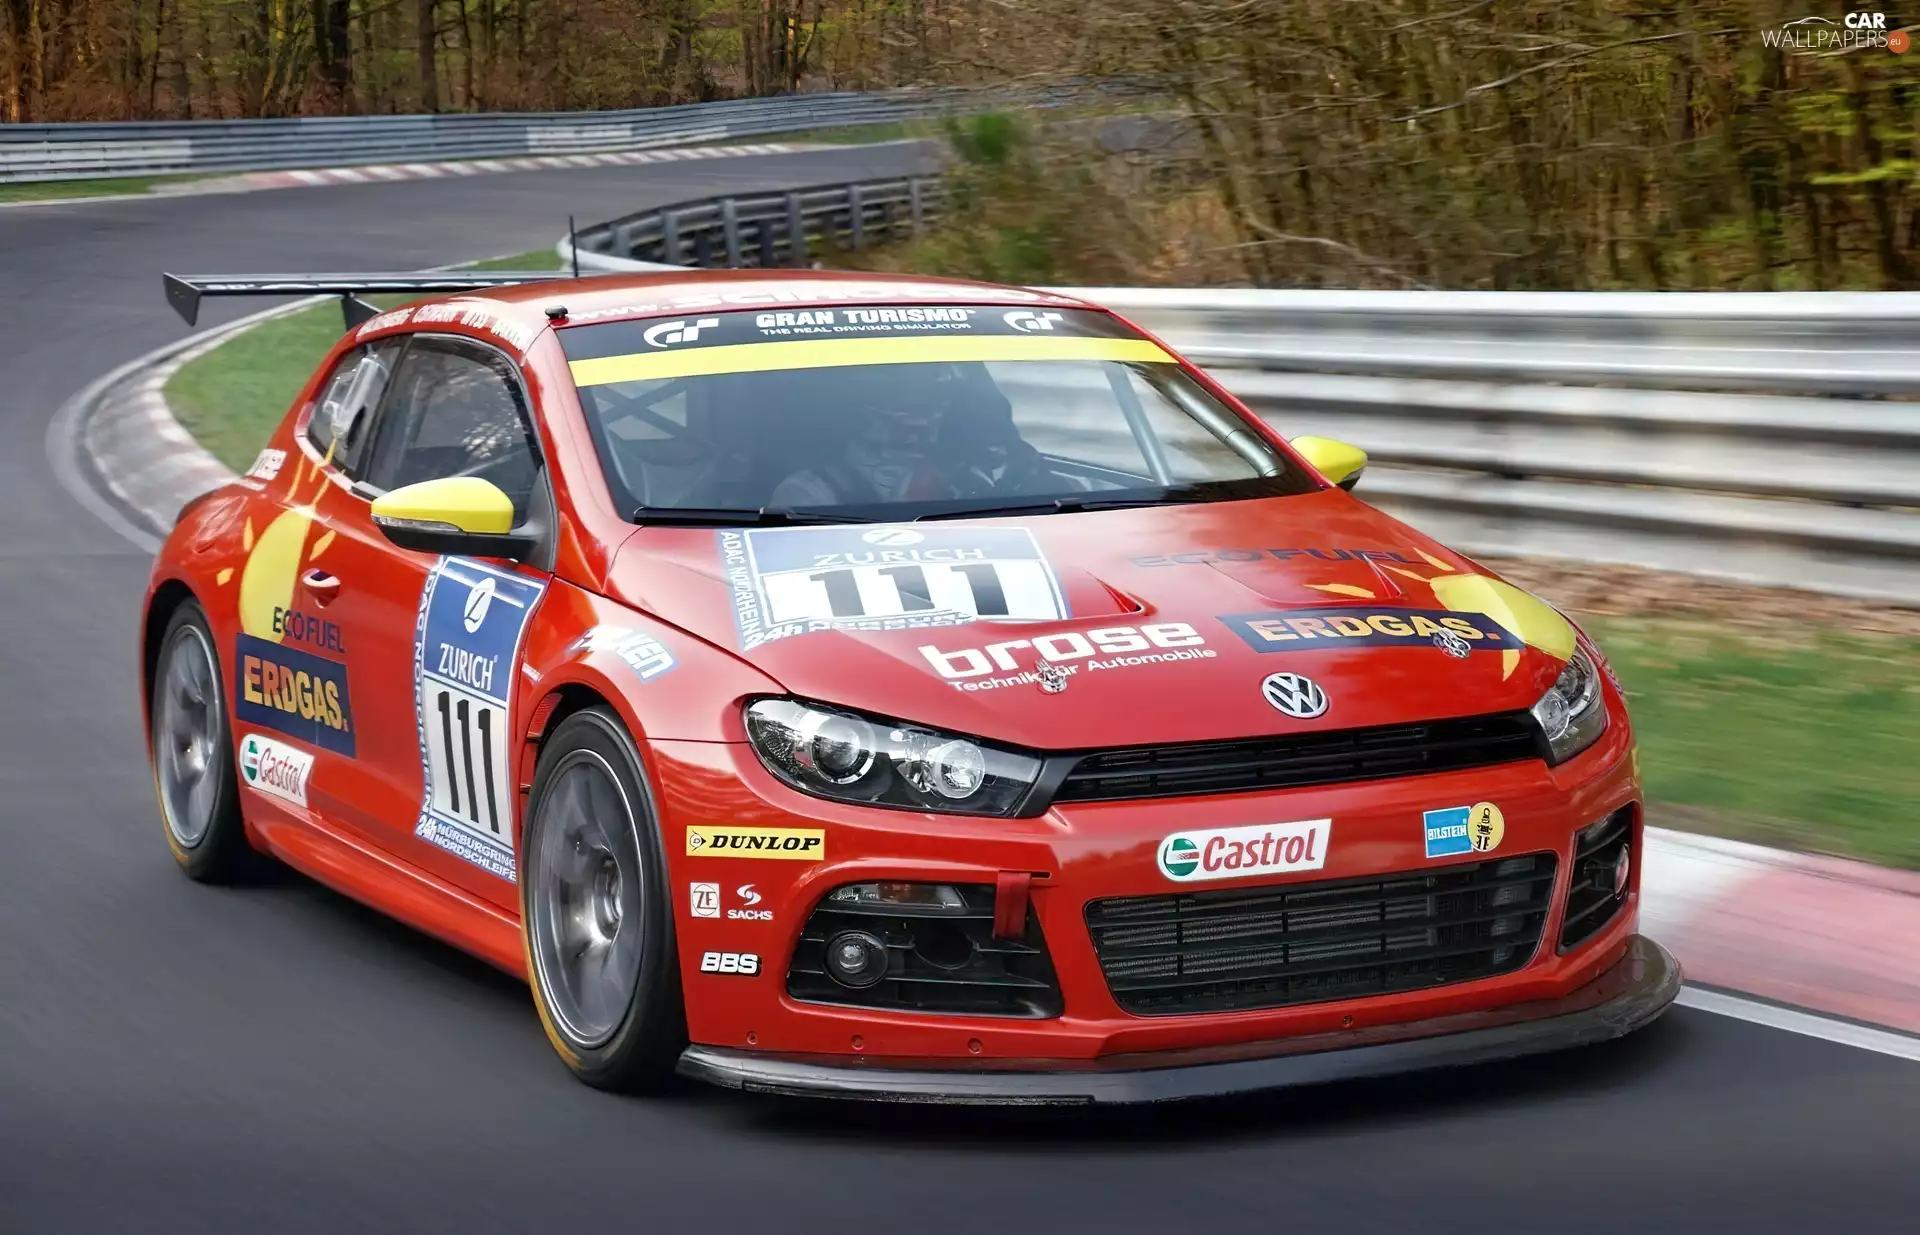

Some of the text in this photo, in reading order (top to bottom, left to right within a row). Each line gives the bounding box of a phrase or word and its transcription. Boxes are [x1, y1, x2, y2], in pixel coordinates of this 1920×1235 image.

[756, 309, 968, 327] GRAN TURISMO
[760, 323, 971, 336] THE REAL DRIVING SIMULATOR
[720, 531, 741, 566] ADAC
[814, 548, 985, 567] ZURICH
[1129, 548, 1425, 567] ECOFUEL
[810, 563, 1009, 619] 111
[272, 606, 345, 654] ECOFUEL
[438, 642, 494, 691] ZURICH
[918, 622, 1205, 678] brose
[948, 671, 1041, 692] Technik
[1088, 649, 1217, 671] Automobile
[259, 747, 305, 798] Castrol
[438, 691, 500, 835] 111
[709, 835, 820, 850] DUNLOP
[1203, 828, 1315, 872] Castrol
[1428, 825, 1467, 841] BILSTEIN
[435, 834, 518, 882] NORDSCHLEIFE
[693, 891, 716, 909] ZF
[728, 909, 773, 920] SACHS
[701, 952, 759, 975] BBS
